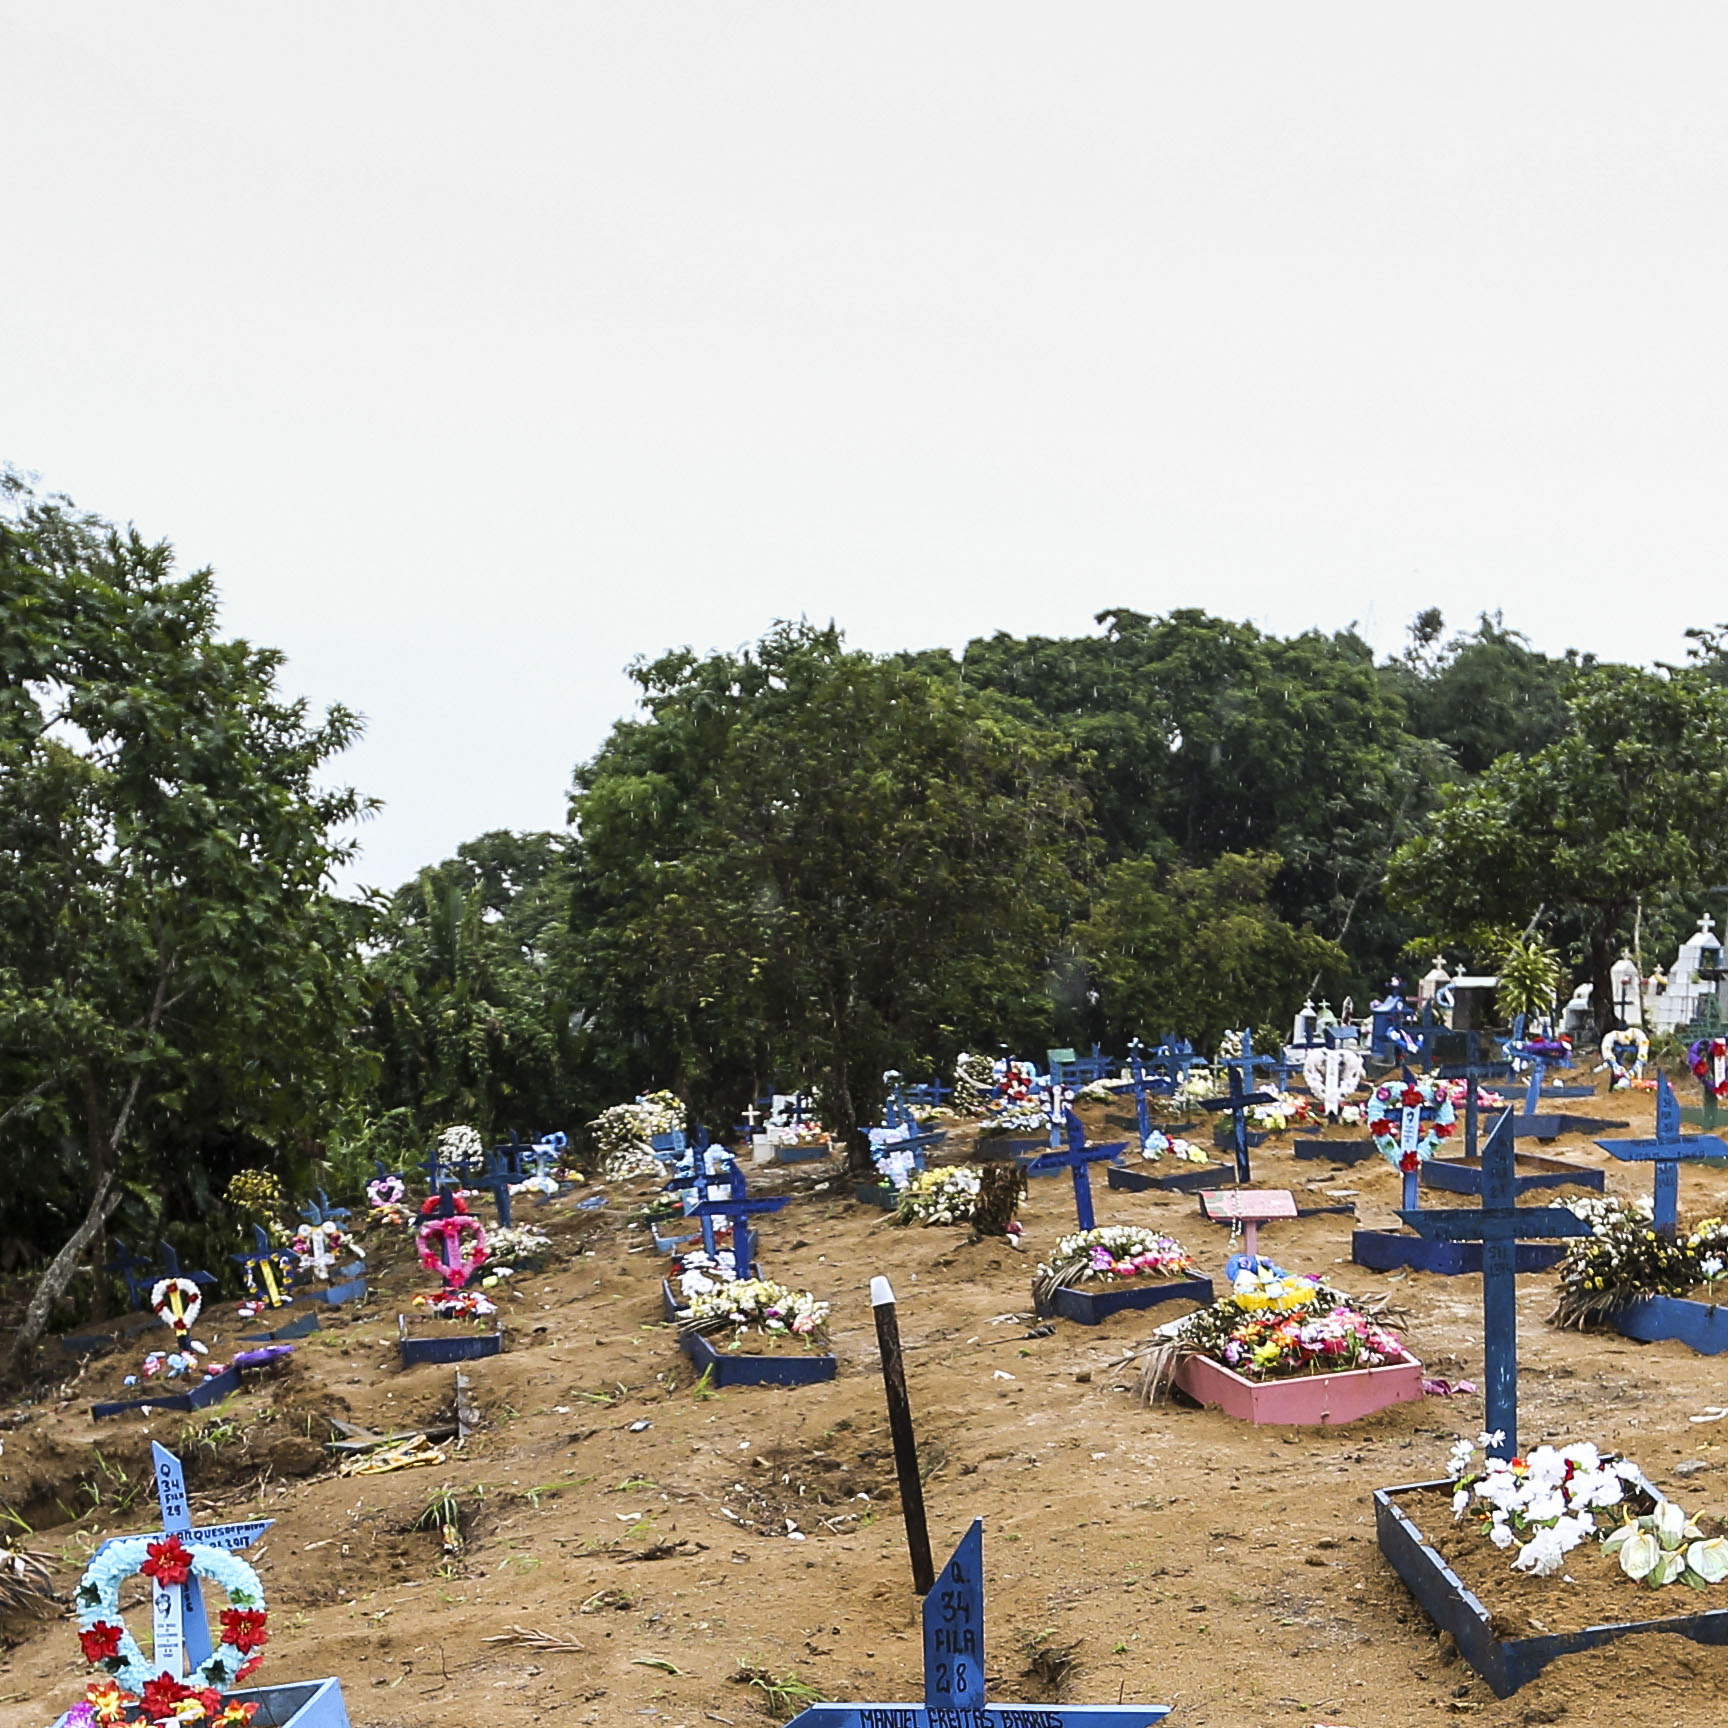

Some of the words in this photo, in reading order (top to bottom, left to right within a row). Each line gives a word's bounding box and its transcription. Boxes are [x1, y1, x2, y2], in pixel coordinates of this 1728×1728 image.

[160, 1463, 170, 1478] Q
[160, 1479, 179, 1493] 34
[940, 1590, 970, 1624] 34
[934, 1628, 976, 1654] FILA
[935, 1662, 967, 1693] 28
